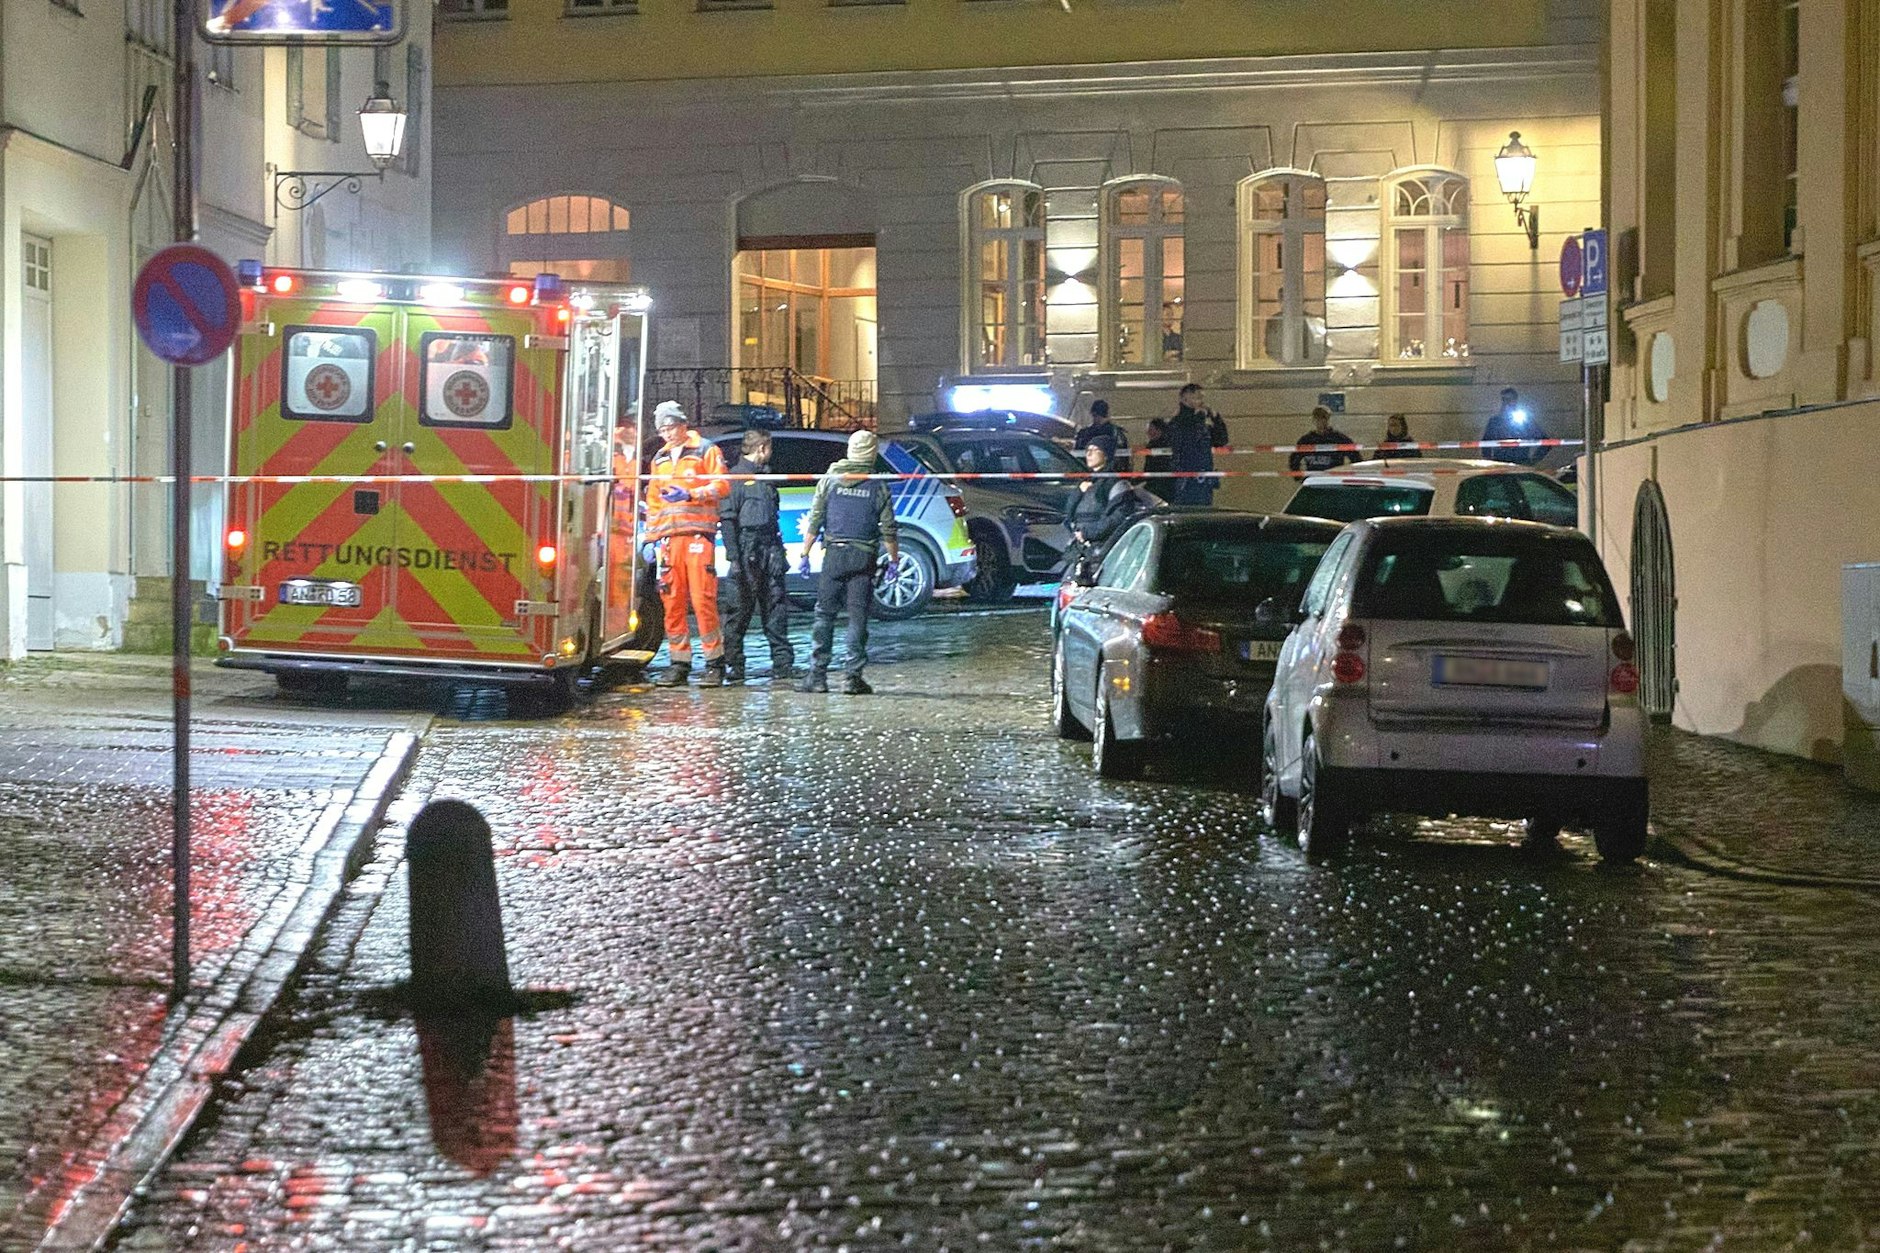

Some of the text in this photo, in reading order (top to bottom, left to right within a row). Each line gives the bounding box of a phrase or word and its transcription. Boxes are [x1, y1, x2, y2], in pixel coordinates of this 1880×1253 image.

[1585, 237, 1600, 287] P
[836, 487, 870, 498] POLIZEI
[264, 540, 517, 573] RETTUNGSDIENST
